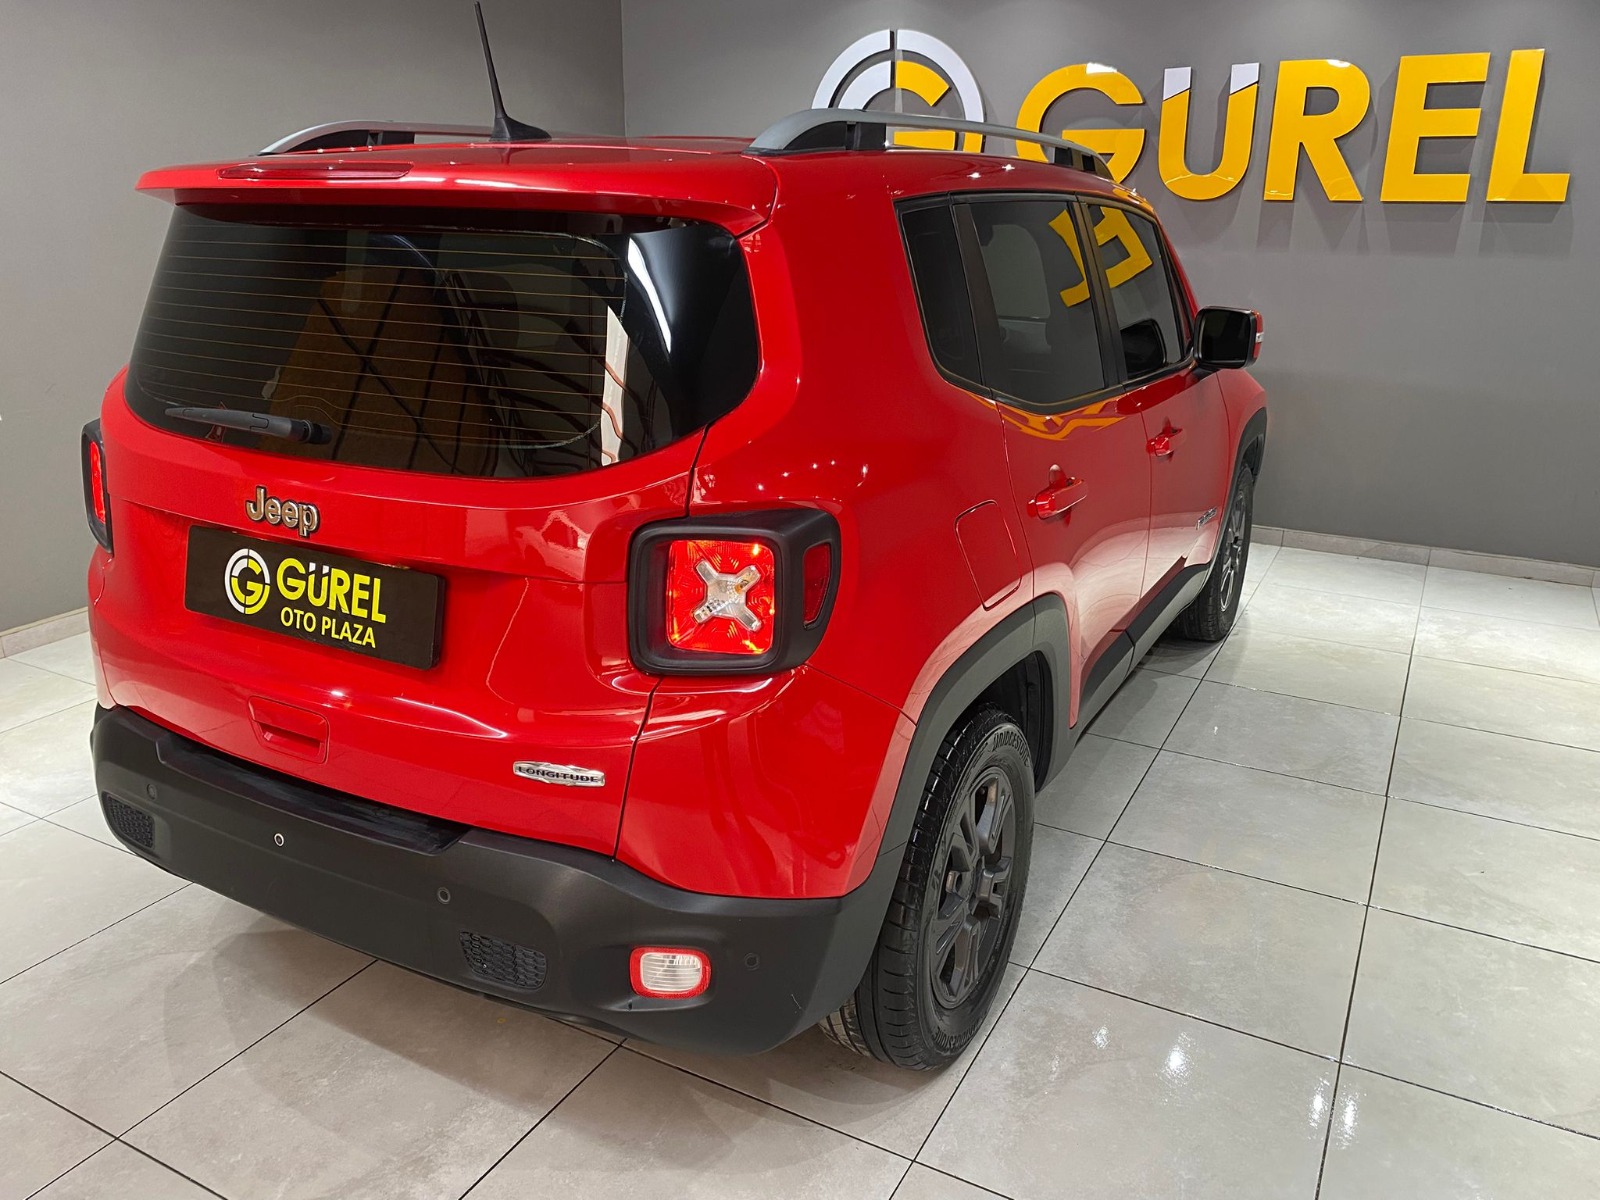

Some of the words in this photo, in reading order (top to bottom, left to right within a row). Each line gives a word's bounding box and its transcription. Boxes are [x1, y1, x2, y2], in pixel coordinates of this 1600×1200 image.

[245, 487, 319, 537] Jeep
[276, 557, 386, 623] GÜREL
[280, 606, 317, 632] OTO
[321, 618, 376, 648] PLAZA
[517, 766, 600, 783] LONGITUDE
